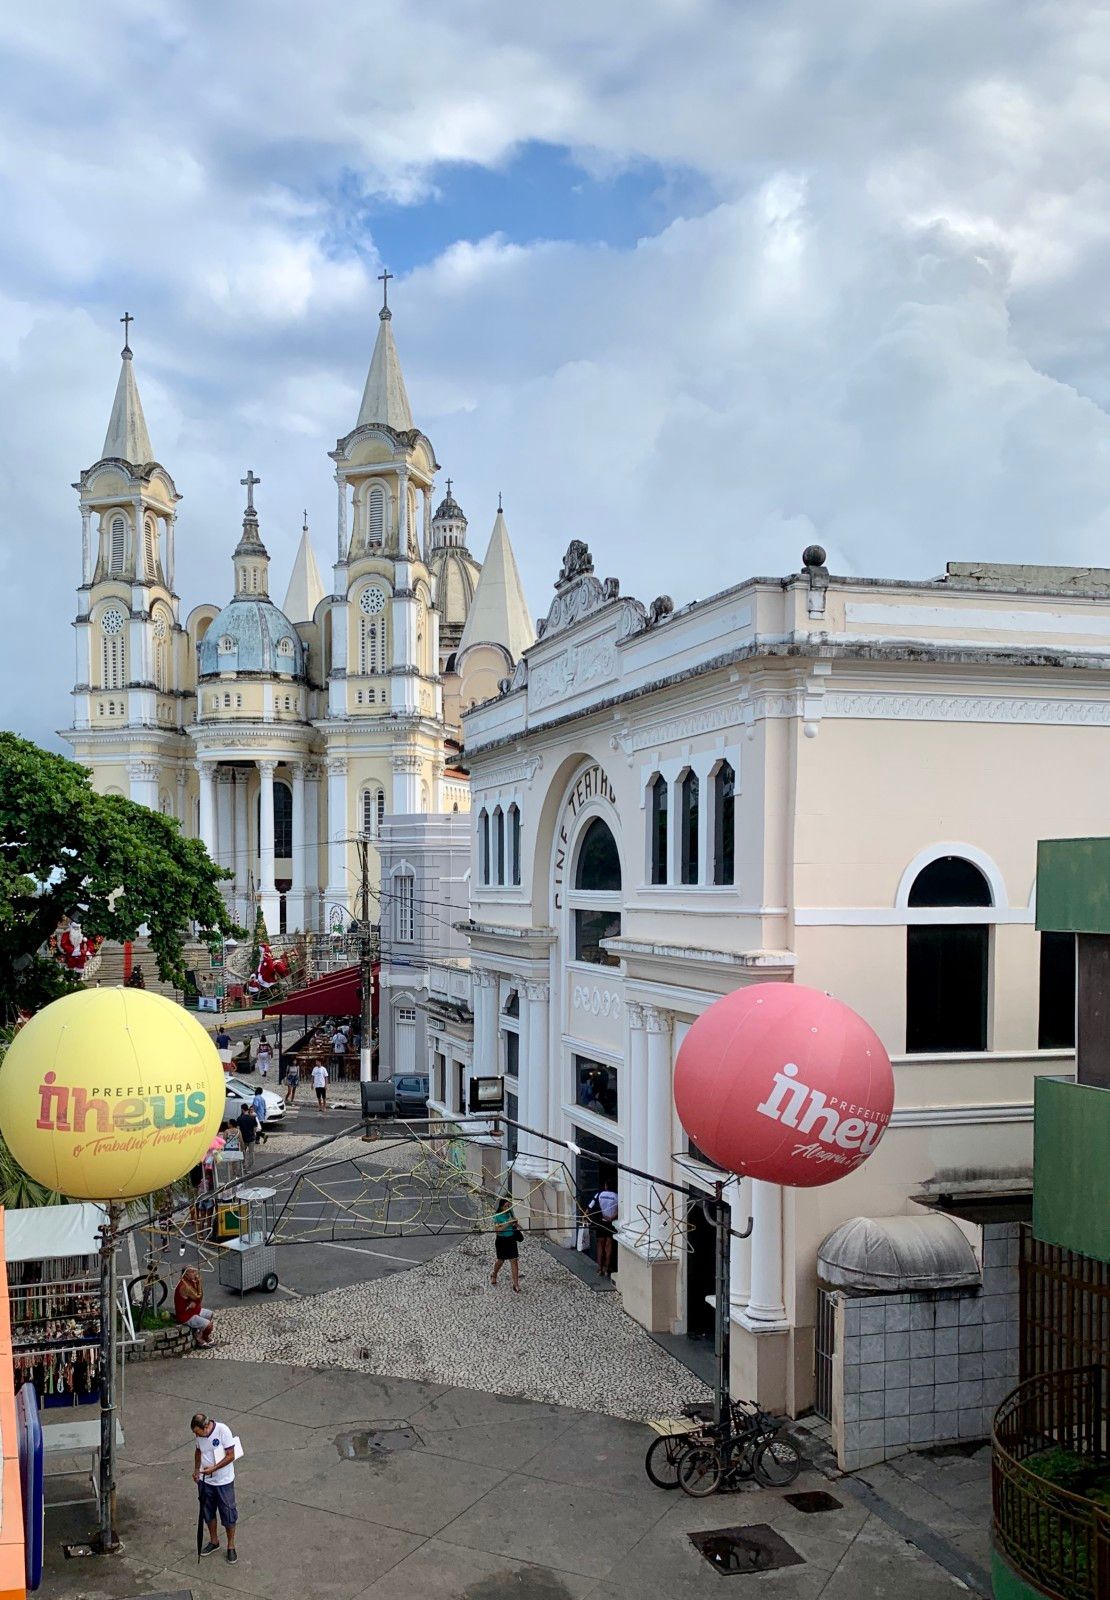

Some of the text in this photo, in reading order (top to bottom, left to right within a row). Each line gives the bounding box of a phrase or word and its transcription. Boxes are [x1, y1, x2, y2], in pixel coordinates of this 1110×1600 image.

[92, 1081, 205, 1097] PREFEITURA DE
[86, 1136, 148, 1157] Trabalho
